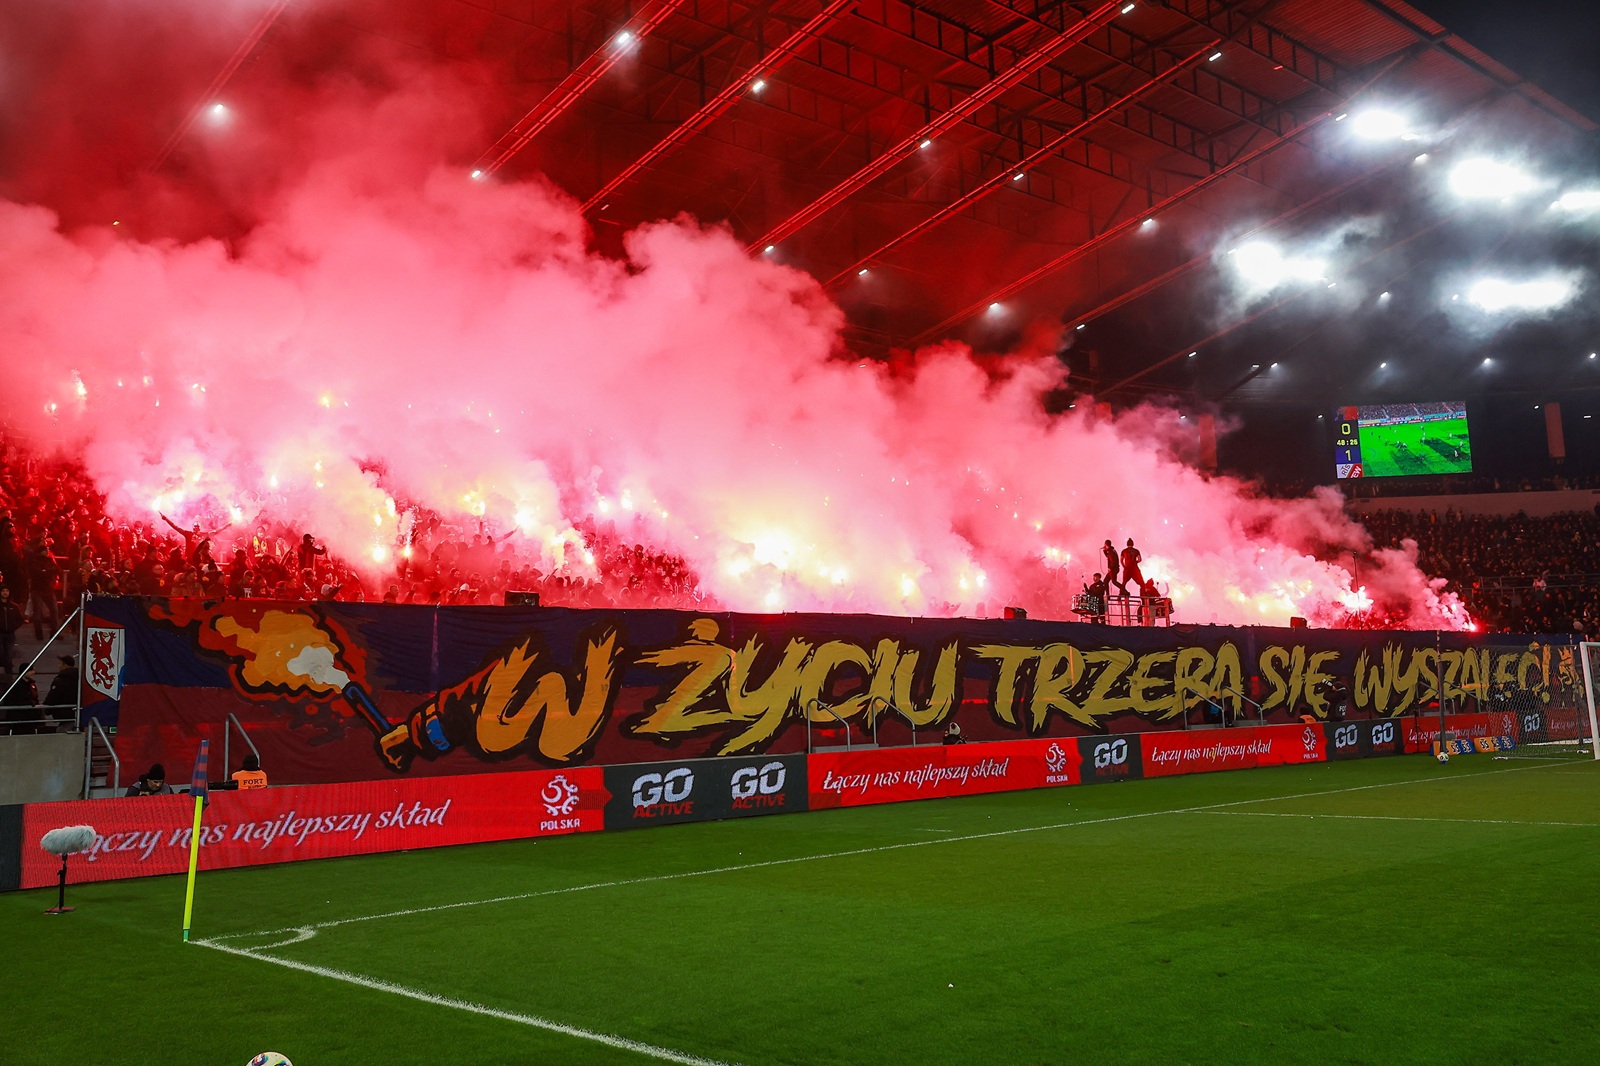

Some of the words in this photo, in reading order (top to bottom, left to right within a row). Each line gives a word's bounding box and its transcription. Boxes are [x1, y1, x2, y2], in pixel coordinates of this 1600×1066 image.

[1341, 423, 1351, 435] 0
[1345, 449, 1351, 461] 1
[474, 627, 625, 762] W
[632, 618, 959, 757] ŻYCIU
[968, 639, 1245, 731] TRZEBA
[1334, 724, 1358, 748] GO
[1371, 722, 1394, 745] GO
[1093, 738, 1128, 768] GO
[1151, 746, 1181, 766] Łączy
[1183, 748, 1201, 760] nas
[1202, 743, 1247, 763] najlepszy
[1247, 739, 1272, 755] skład
[243, 778, 264, 786] FORT
[631, 767, 695, 808] GO
[730, 761, 786, 800] GO
[823, 771, 871, 794] Łączy
[874, 771, 901, 786] nas
[903, 764, 969, 789] najlepszy
[972, 758, 1010, 778] skład
[633, 801, 694, 818] ACTIVE
[732, 793, 785, 809] ACTIVE
[232, 811, 372, 849] najlepszy
[375, 799, 451, 829] skład
[540, 818, 581, 831] POLSKA
